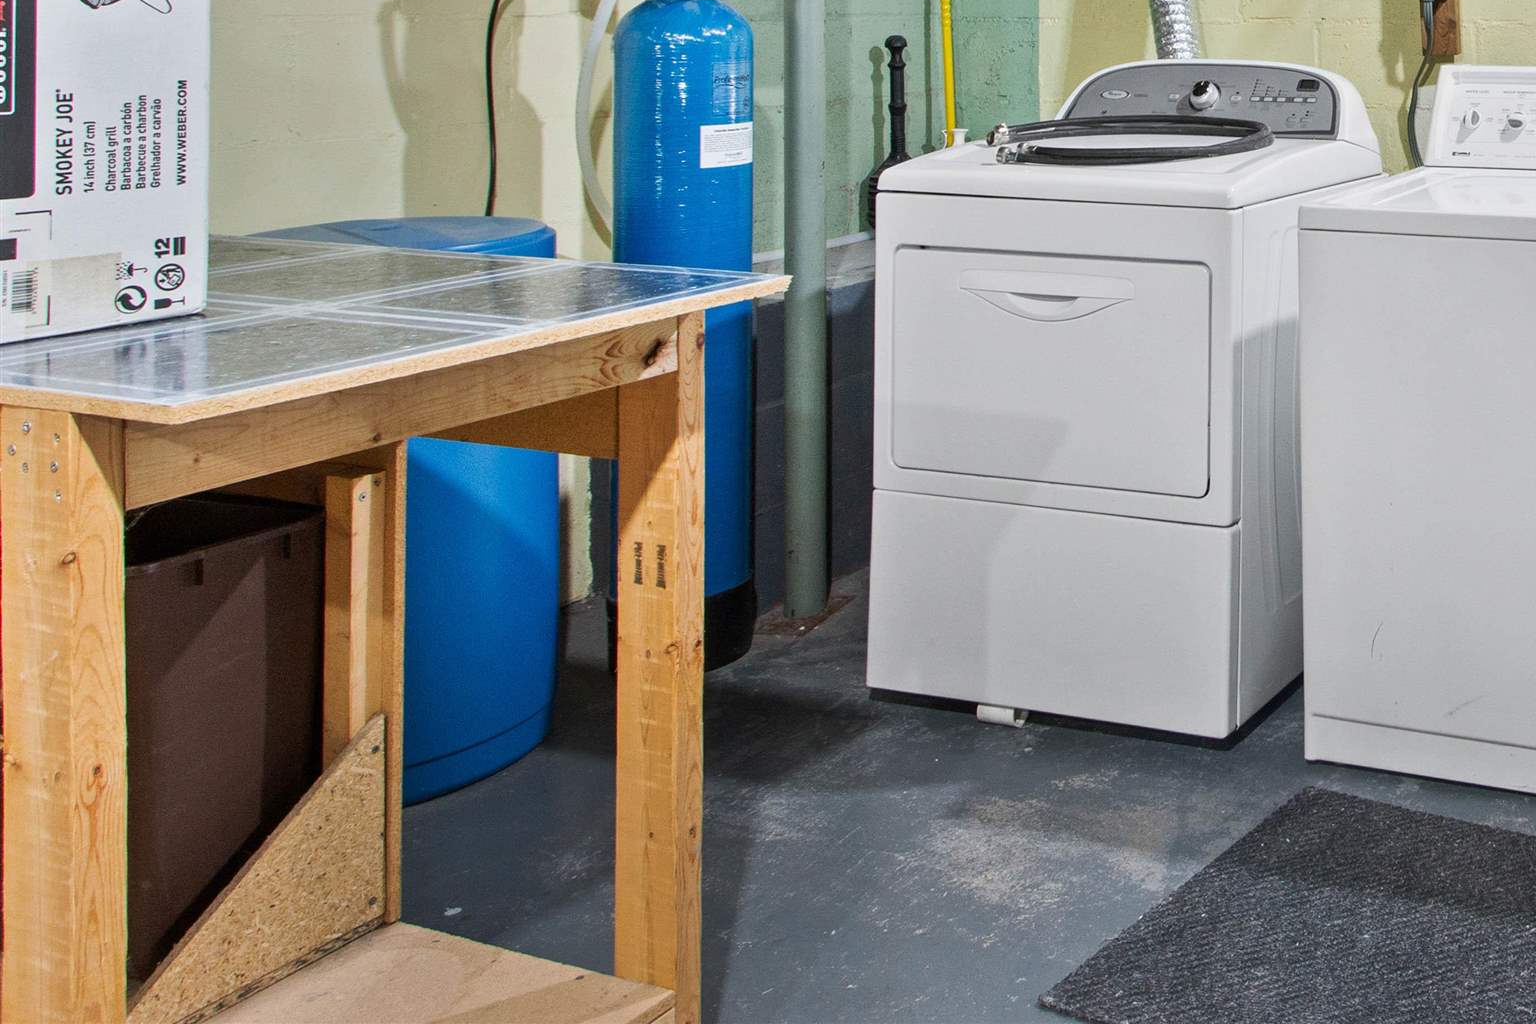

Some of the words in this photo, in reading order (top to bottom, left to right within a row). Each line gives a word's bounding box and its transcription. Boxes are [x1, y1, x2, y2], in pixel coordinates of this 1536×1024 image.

[83, 121, 96, 139] cm)
[120, 102, 133, 136] carbón
[136, 94, 148, 134] charbon
[151, 98, 162, 131] carvão
[83, 142, 96, 157] (37
[105, 125, 119, 147] grill
[176, 79, 187, 186] WWW.WEBER.COM
[55, 128, 73, 196] SMOKEY
[83, 159, 95, 180] inch
[105, 149, 117, 192] Charcoal
[120, 145, 132, 191] Barbacoa
[135, 144, 147, 190] Barbecue
[150, 140, 161, 189] Grelhador
[83, 181, 95, 193] 14
[154, 238, 171, 260] 12
